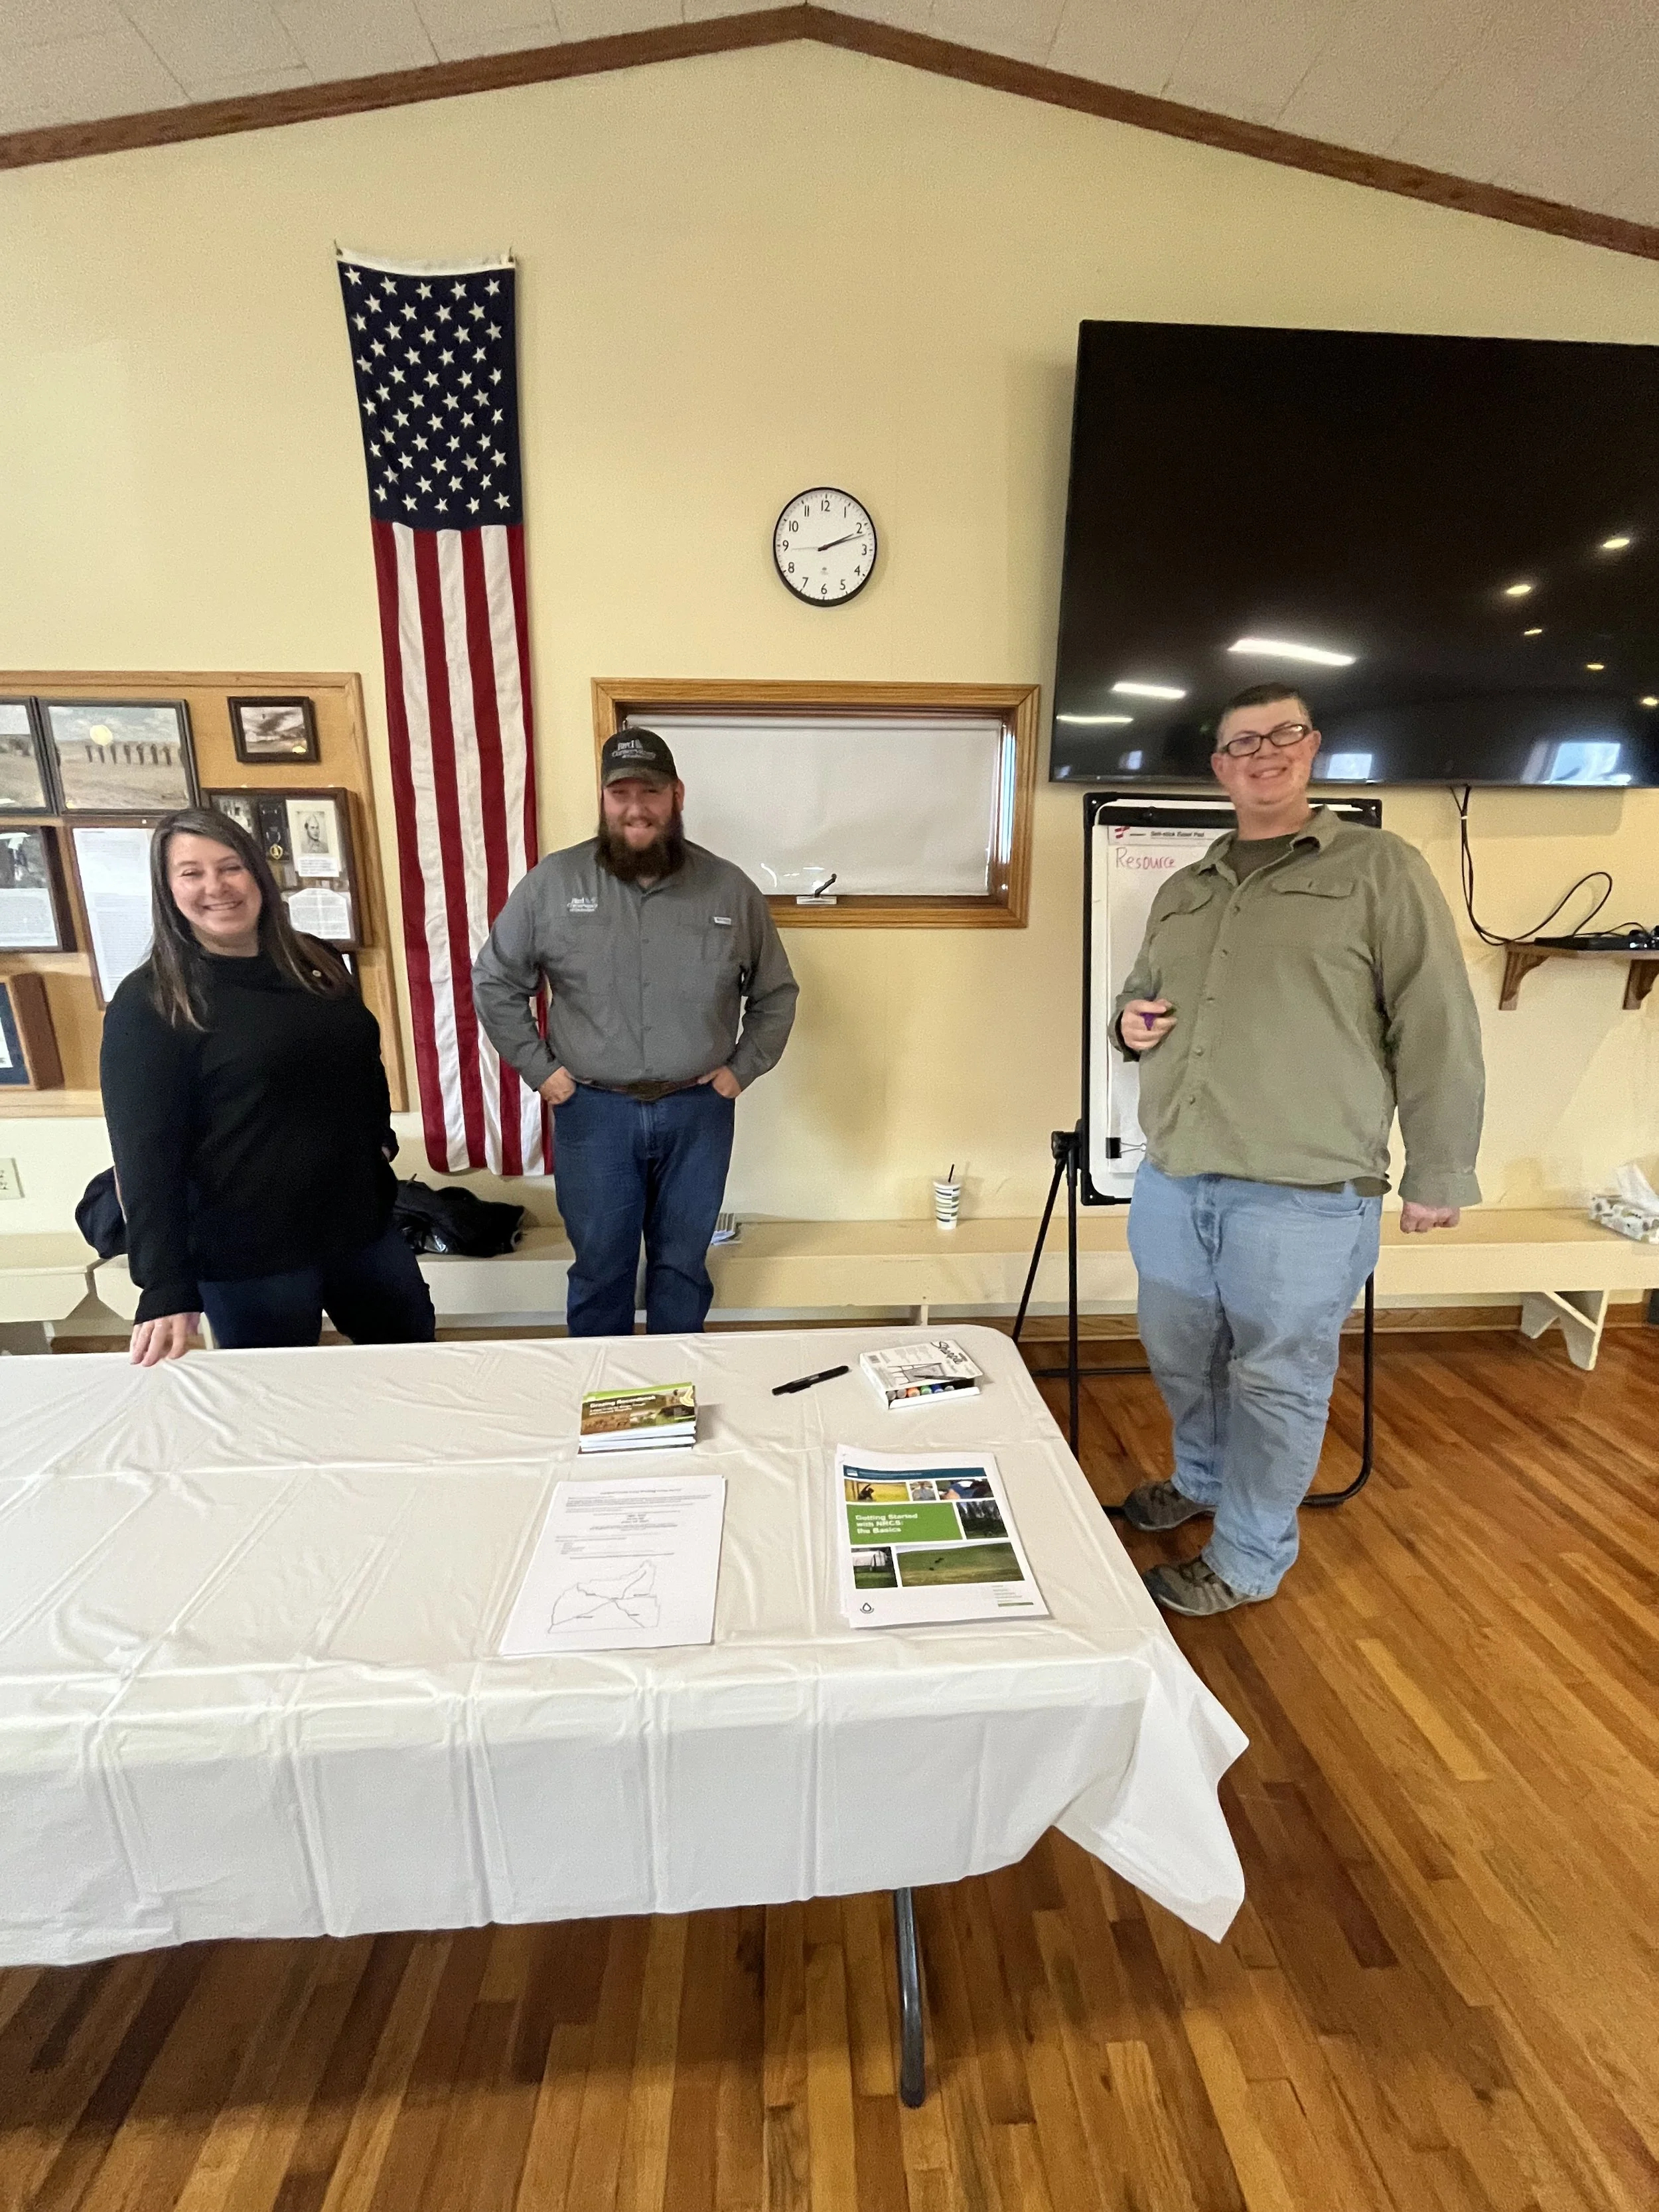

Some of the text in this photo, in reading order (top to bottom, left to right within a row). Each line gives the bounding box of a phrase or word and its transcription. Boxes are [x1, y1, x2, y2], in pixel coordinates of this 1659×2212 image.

[804, 506, 810, 517] 11
[821, 500, 831, 512] 12
[843, 506, 847, 518] 1
[788, 520, 799, 532] 10
[855, 522, 863, 534] 2
[782, 540, 789, 552] 9
[861, 544, 867, 555] 3
[788, 561, 795, 573] 8
[854, 565, 861, 576] 4
[802, 577, 809, 588] 7
[839, 579, 846, 590] 5
[821, 583, 828, 595] 6
[1116, 846, 1175, 870] Resource
[930, 1341, 964, 1364] Sharpie
